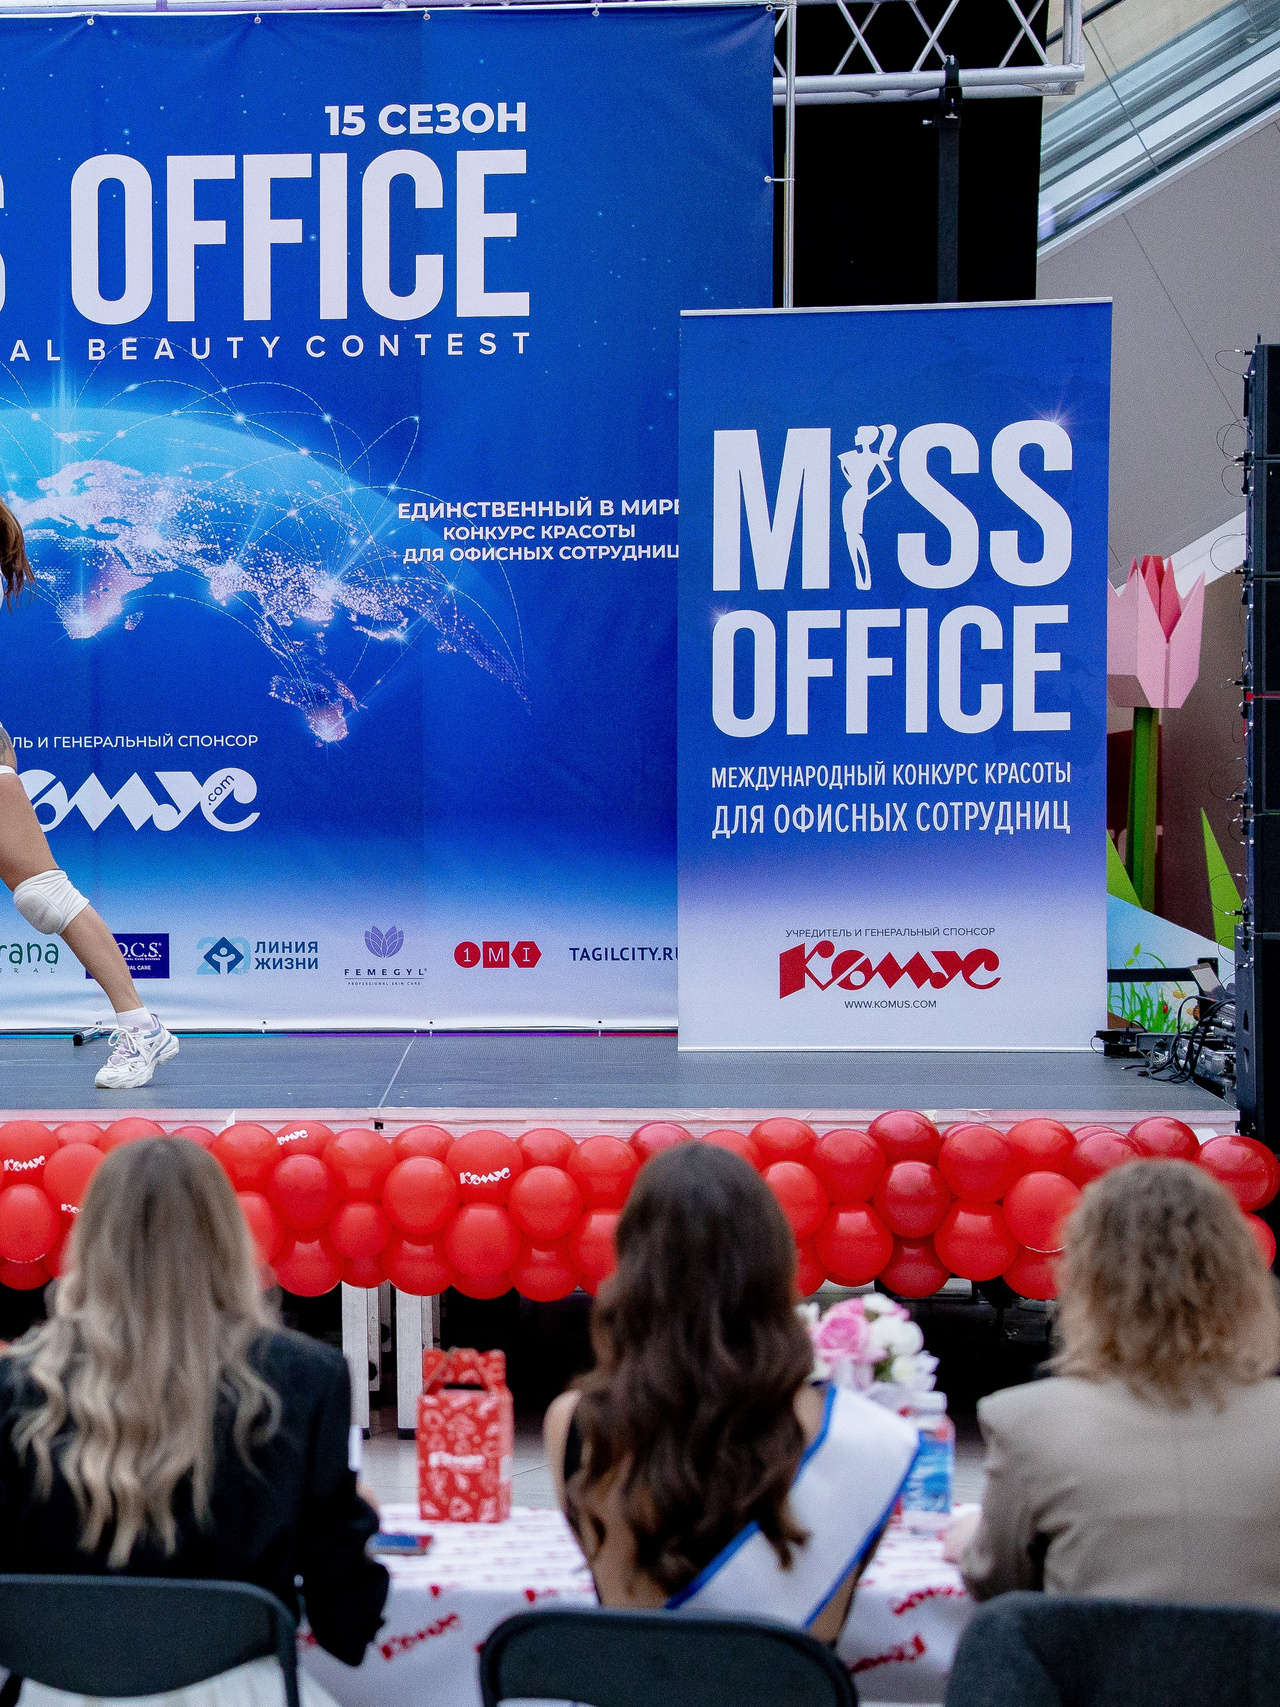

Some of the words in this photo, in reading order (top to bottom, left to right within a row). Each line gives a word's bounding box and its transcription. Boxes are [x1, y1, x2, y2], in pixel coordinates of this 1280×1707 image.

[324, 104, 365, 136] 15
[378, 102, 526, 136] СЕЗОН
[70, 149, 530, 325] OFFICE
[88, 336, 280, 361] BEAUTY
[306, 332, 530, 359] CONTEST
[398, 497, 593, 521] ЕДИНСТВЕННЫЙ
[600, 500, 614, 516] В
[443, 525, 535, 541] КОНКУРС
[541, 524, 636, 539] КРАСОТЫ
[403, 548, 444, 564] ДЛЯ
[450, 547, 553, 562] ОФИСНЫХ
[712, 605, 1072, 738] OFFICE
[38, 736, 48, 748] И
[53, 733, 173, 749] ГЕНЕРАЛЬНЫЙ
[178, 734, 258, 748] СПОНСОР
[711, 761, 885, 790] МЕЖДУНАРОДНЫЙ
[893, 763, 978, 786] КОНКУРС
[985, 761, 1071, 784] КРАСОТЫ
[208, 775, 235, 806] .com
[712, 804, 765, 839] ДЛЯ
[774, 802, 907, 834] ОФИСНЫХ
[916, 800, 1071, 834] СОТРУДНИЦ
[786, 929, 852, 938] УЧРЕДИТЕЛЬ
[854, 929, 862, 937] И
[865, 926, 940, 937] ГЕНЕРАЛЬНЫЙ
[943, 927, 995, 937] СПОНСОР
[117, 942, 161, 957] O.C.S.
[255, 941, 318, 954] ЛИНИЯ
[569, 947, 678, 961] TAGILCITY.R
[255, 957, 319, 970] ЖИЗНИ
[344, 968, 424, 976] FEMEGYL
[844, 1000, 937, 1009] WWW.KOMUS.COM
